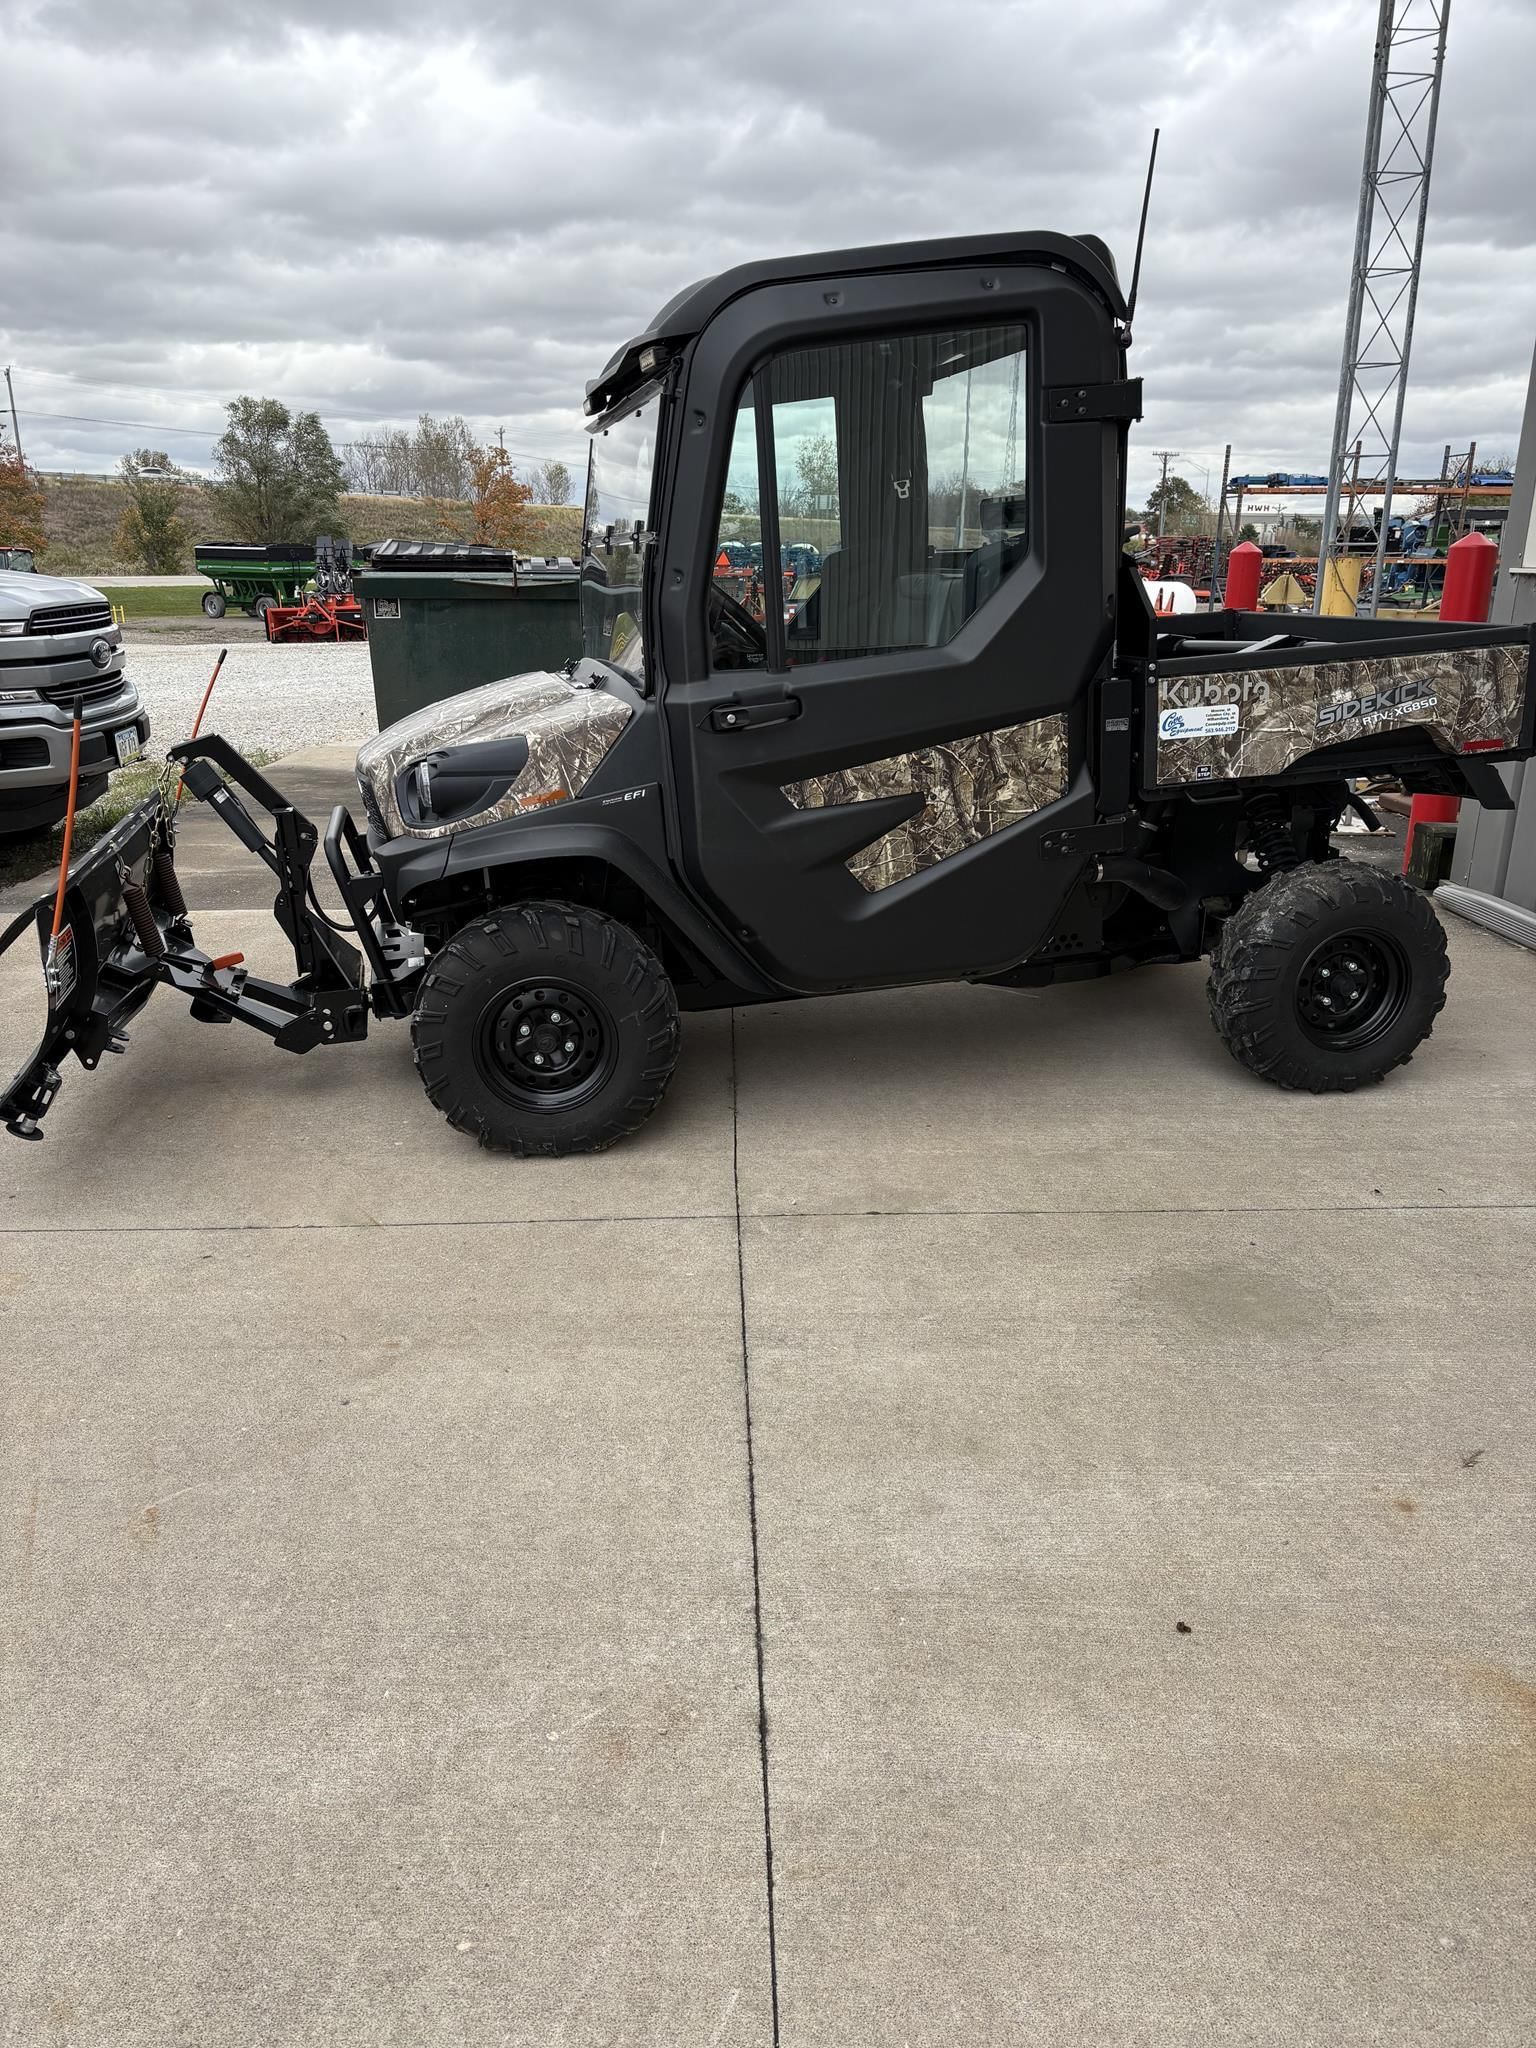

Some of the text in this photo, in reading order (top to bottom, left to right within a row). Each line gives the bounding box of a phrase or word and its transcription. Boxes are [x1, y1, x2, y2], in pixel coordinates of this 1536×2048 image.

[1247, 504, 1270, 512] HWH
[1162, 676, 1270, 707] Kubota
[1315, 678, 1437, 728] SIDEKICK
[1362, 697, 1438, 726] RTV-XG850
[1169, 726, 1204, 737] Equipment
[624, 789, 646, 801] EFI
